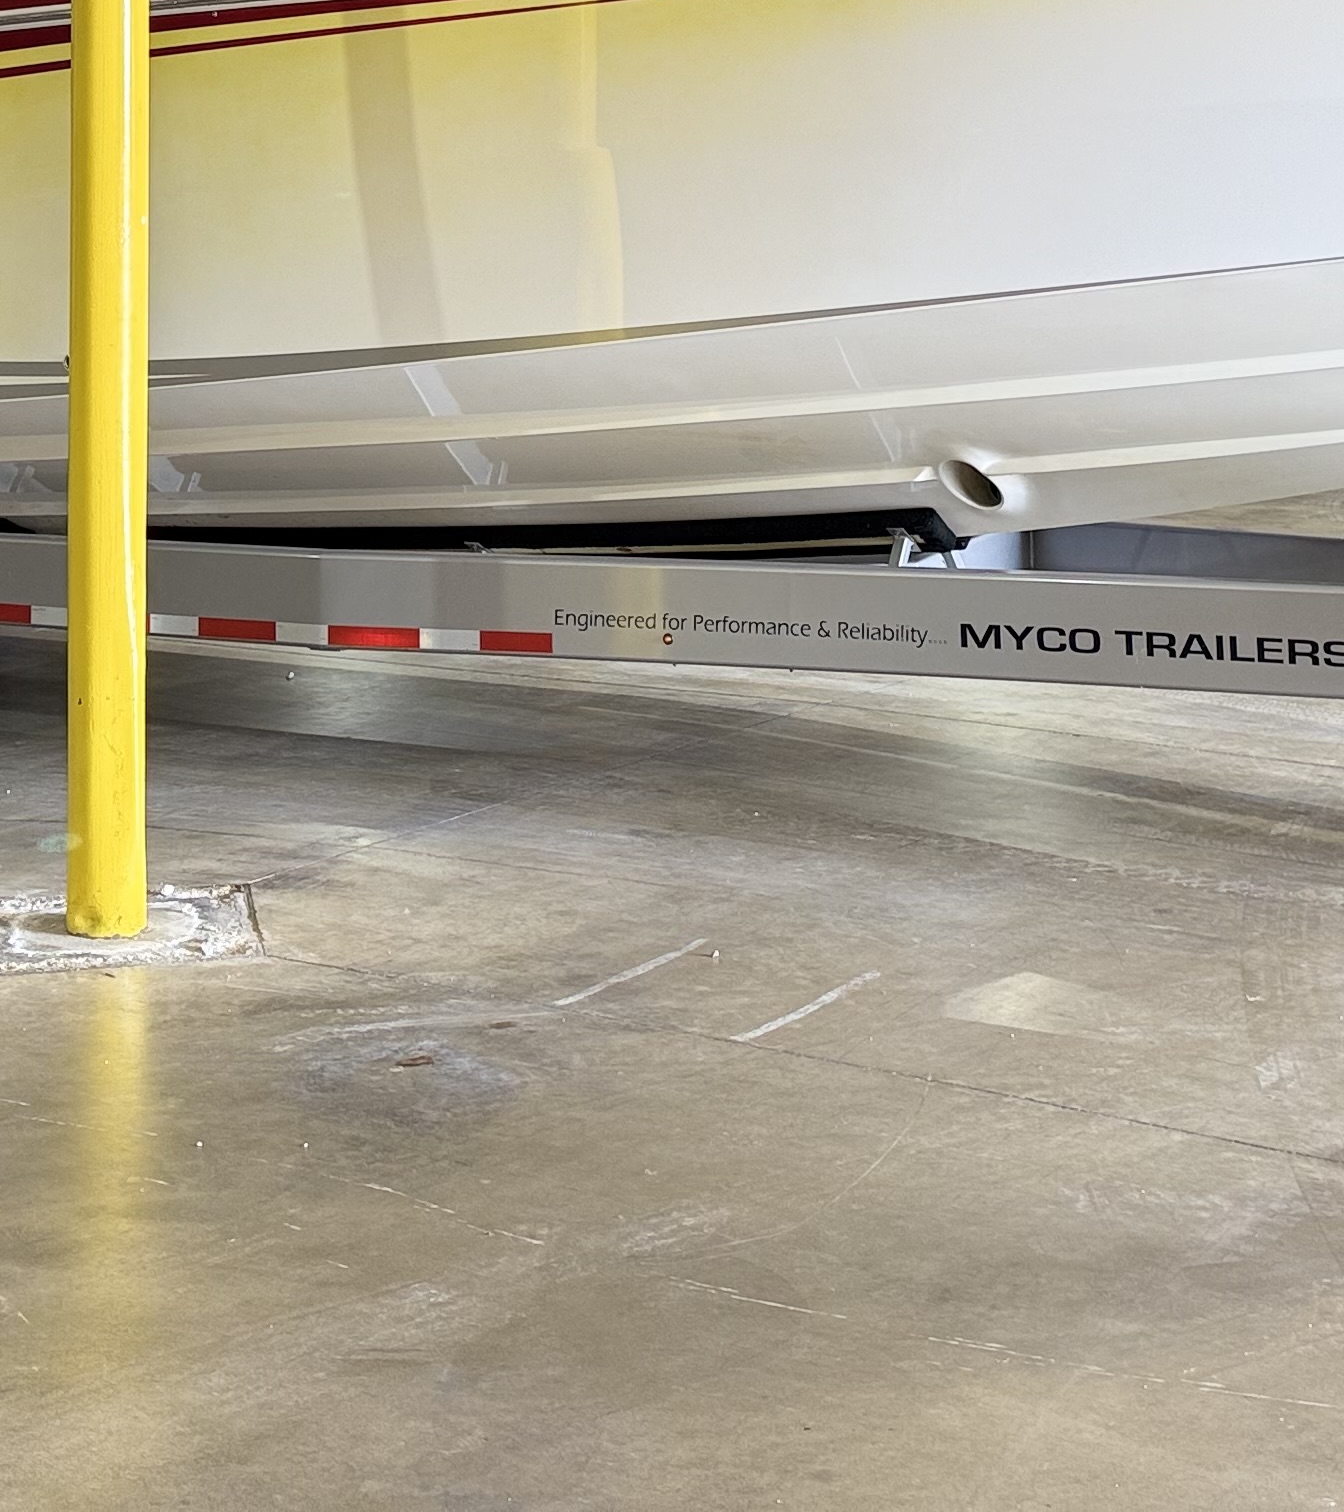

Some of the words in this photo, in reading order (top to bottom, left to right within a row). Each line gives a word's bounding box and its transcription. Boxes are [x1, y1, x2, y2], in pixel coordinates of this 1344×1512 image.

[554, 609, 656, 631] Engineered
[662, 612, 687, 631] for
[693, 614, 811, 638] Performance
[817, 621, 832, 638] &
[960, 623, 1101, 654] MYCO
